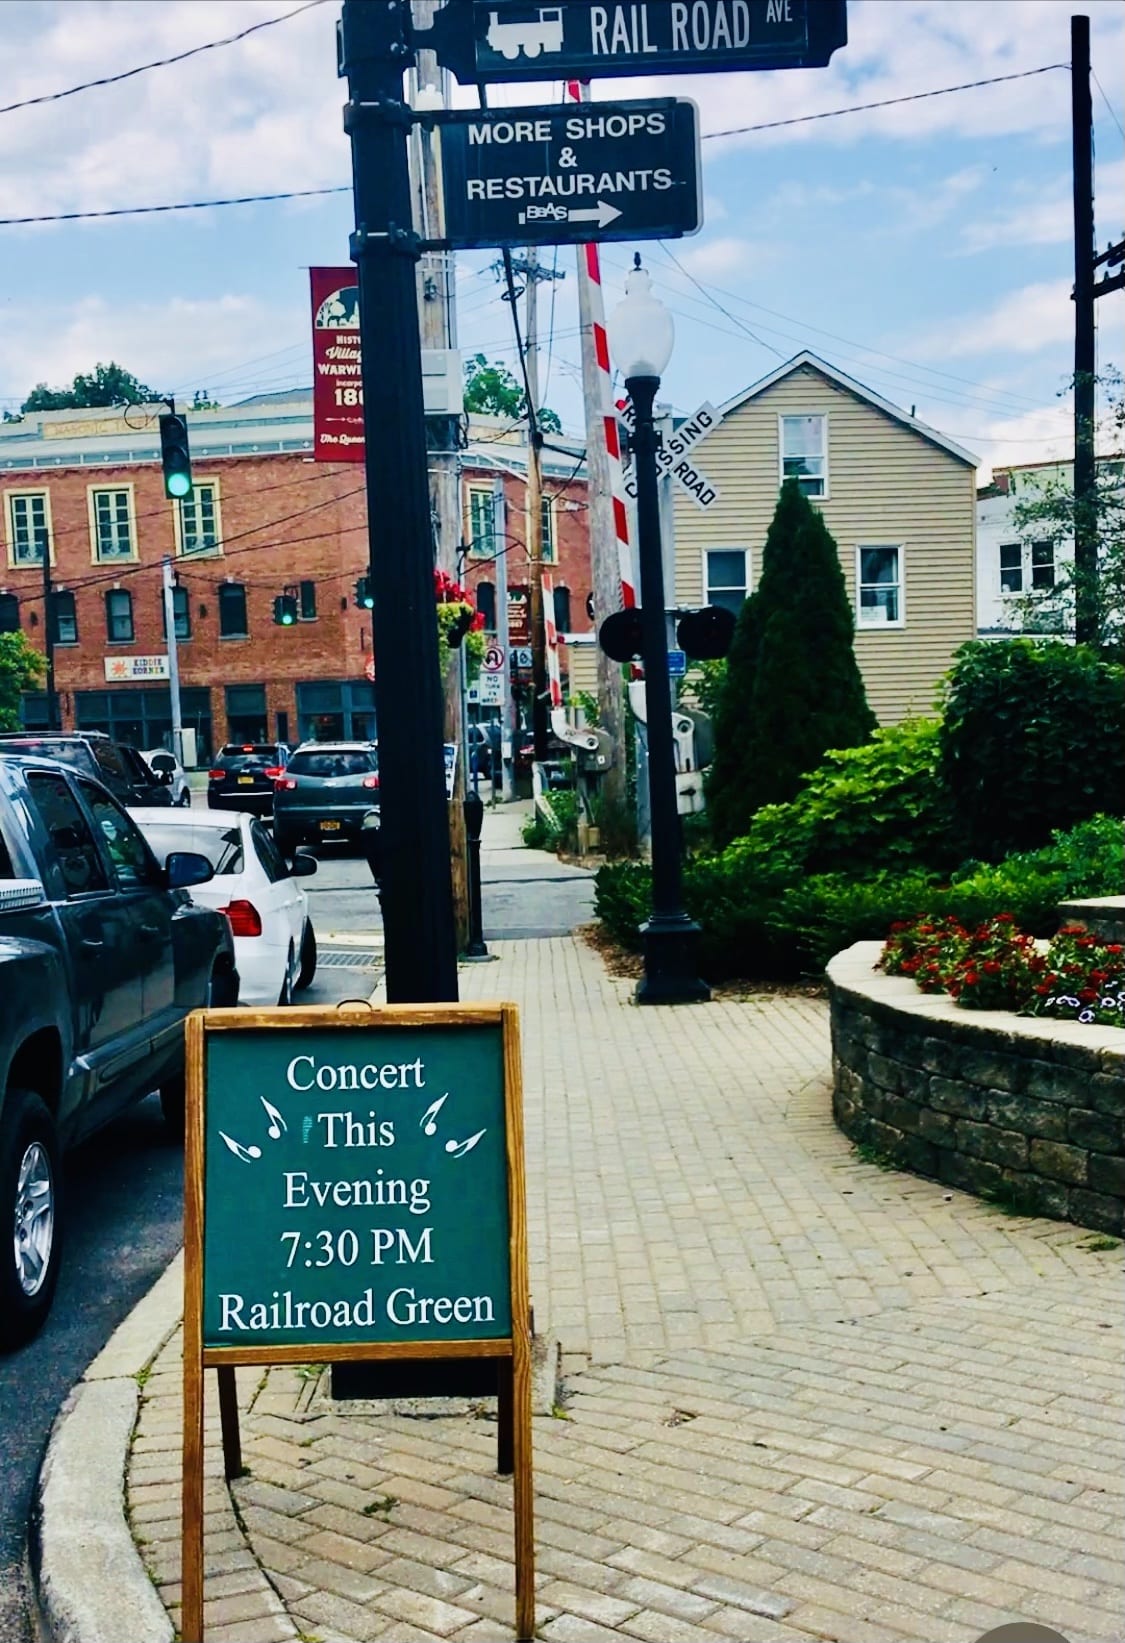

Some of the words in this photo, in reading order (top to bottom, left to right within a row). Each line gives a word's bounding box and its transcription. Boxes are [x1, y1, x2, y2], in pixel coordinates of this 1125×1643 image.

[590, 4, 658, 55] RAIL
[671, 1, 750, 50] ROAD
[766, 0, 792, 23] AVE
[469, 120, 552, 145] MORE
[566, 113, 666, 140] SHOPS
[558, 147, 578, 168] &
[467, 168, 672, 200] RESTAURANTS
[335, 335, 361, 344] HIST
[334, 388, 363, 406] 18
[673, 461, 716, 506] ROAD
[286, 1055, 426, 1091] Concert
[317, 1110, 395, 1148] This
[282, 1168, 431, 1216] Evening
[280, 1229, 359, 1268] 7:30
[370, 1227, 435, 1265] PM
[218, 1288, 376, 1331] Railroad
[386, 1287, 496, 1325] Green
